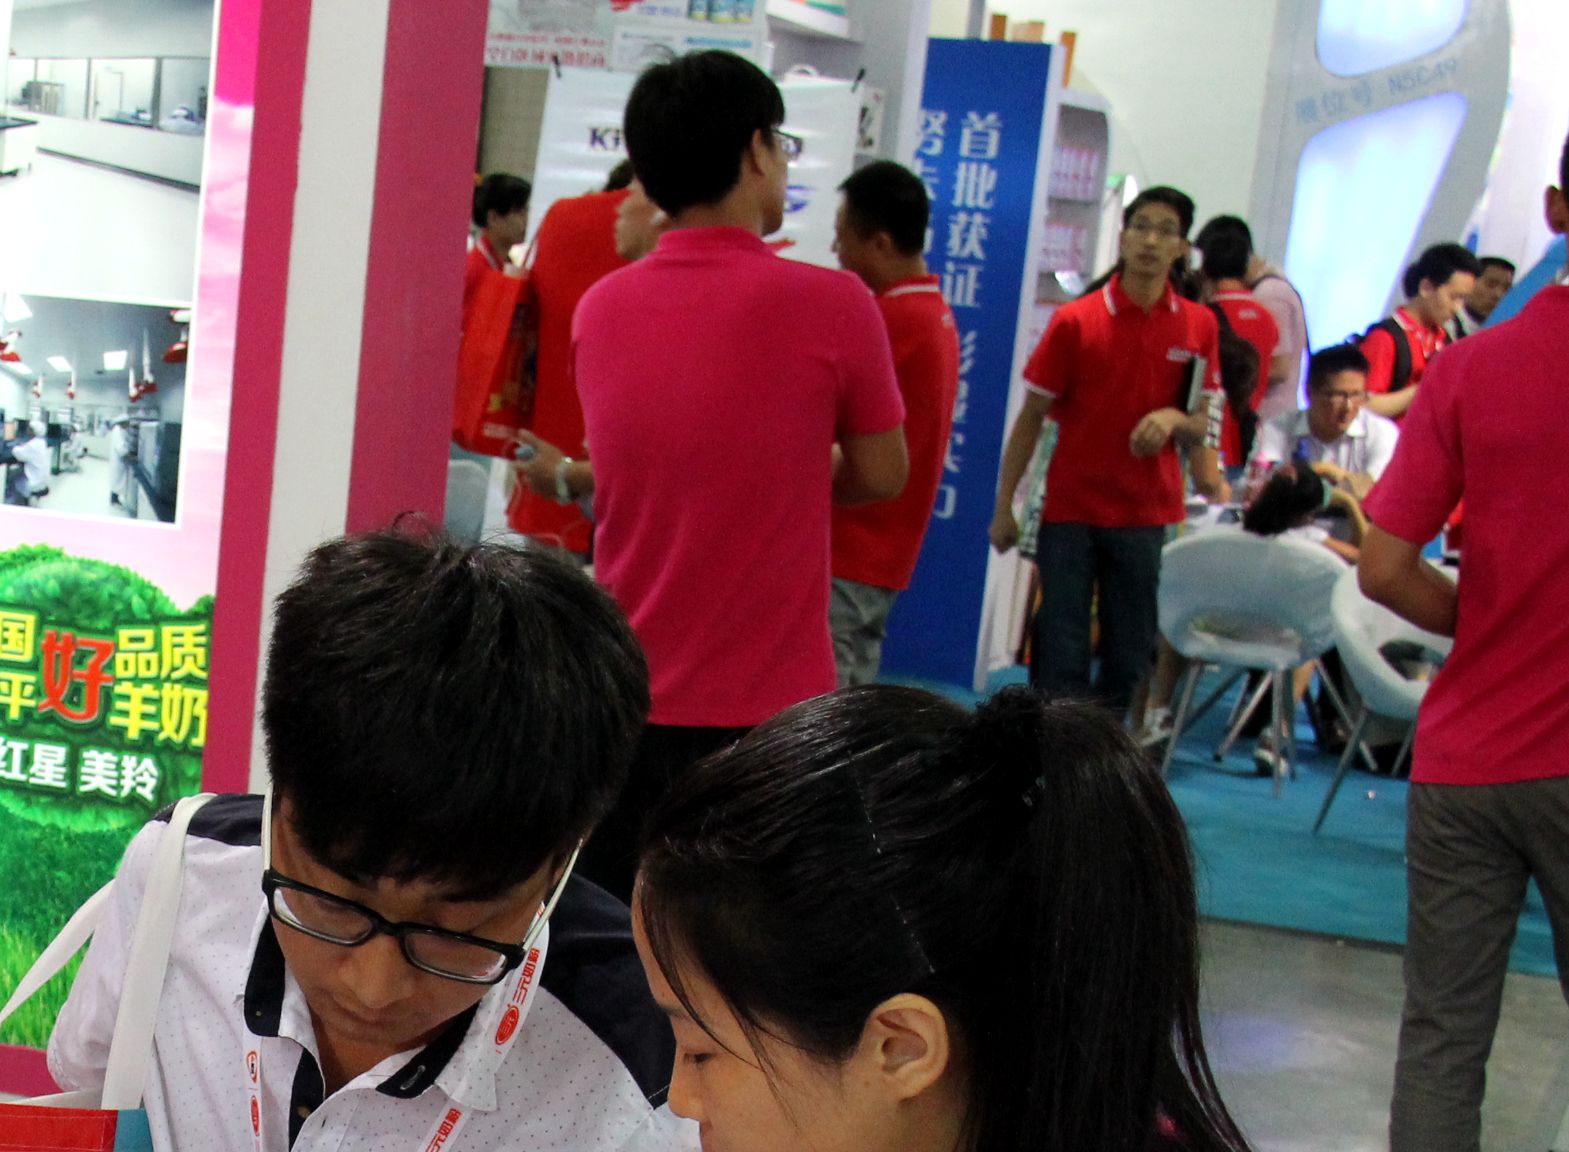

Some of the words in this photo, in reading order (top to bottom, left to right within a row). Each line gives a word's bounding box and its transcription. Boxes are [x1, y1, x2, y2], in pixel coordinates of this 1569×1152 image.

[942, 112, 1002, 308] 首批获证
[38, 629, 116, 723] 好
[114, 623, 208, 680] 品质
[109, 681, 209, 748] 羊奶
[79, 749, 159, 802] 美羚
